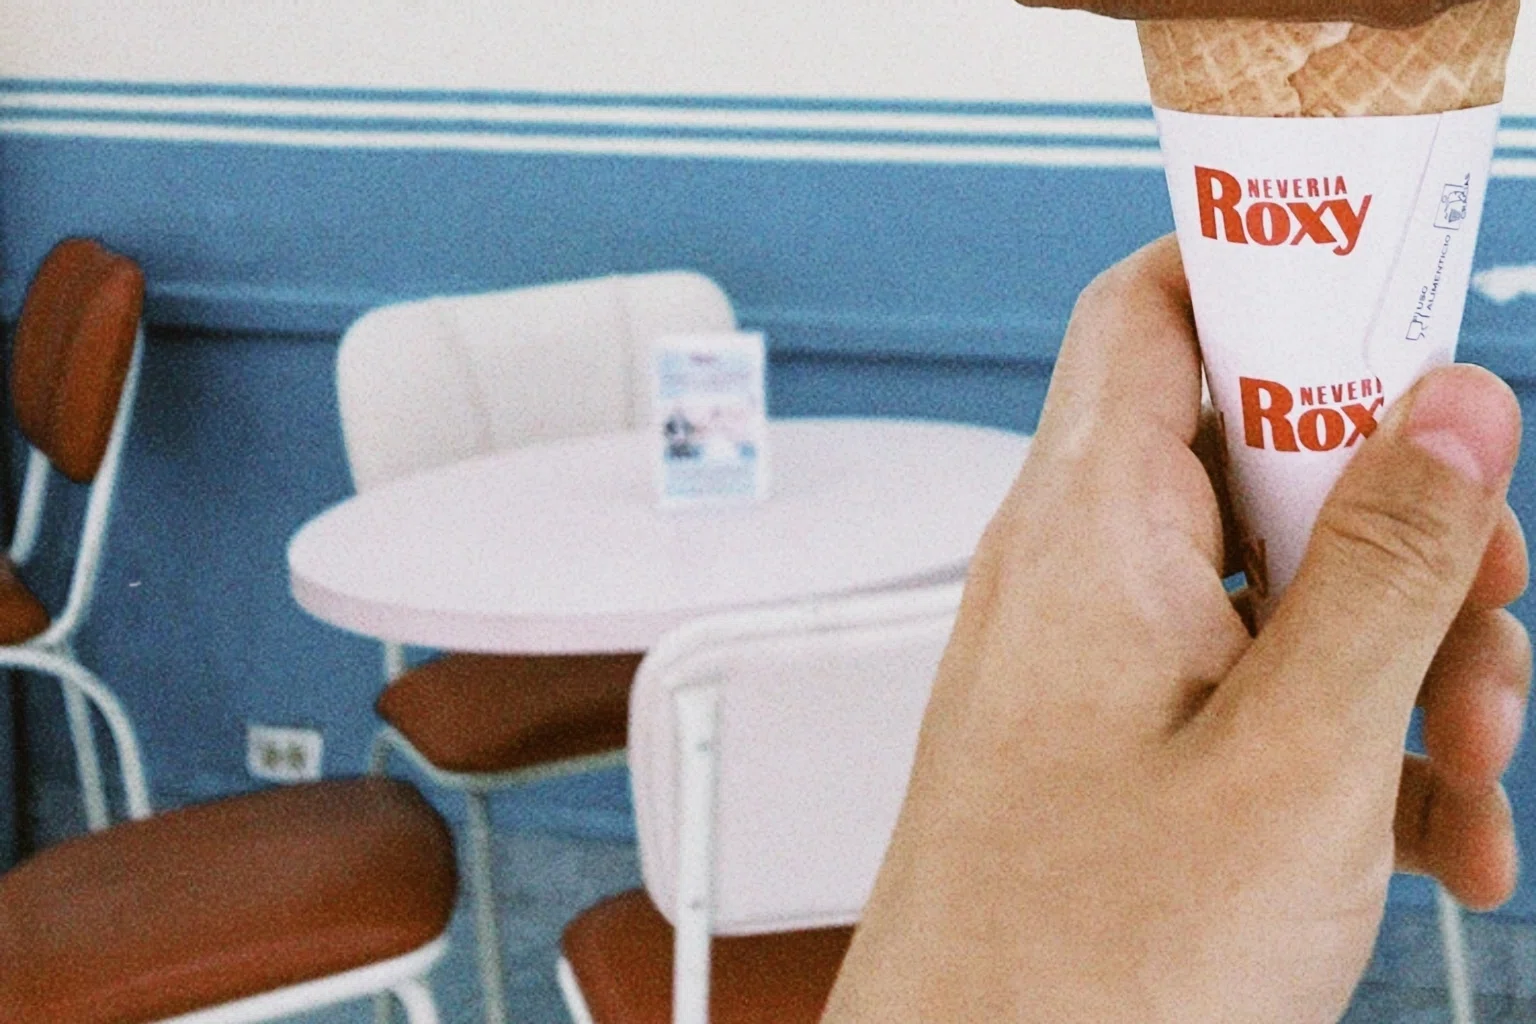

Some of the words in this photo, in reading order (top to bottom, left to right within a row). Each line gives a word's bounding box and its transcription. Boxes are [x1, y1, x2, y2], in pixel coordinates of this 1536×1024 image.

[1193, 165, 1373, 256] Roxy
[1247, 175, 1348, 198] NEVERIA
[1415, 285, 1429, 311] USO
[1425, 233, 1452, 312] ALIMENTICIO
[1239, 375, 1385, 453] Rox
[1299, 376, 1384, 406] NEVERI
